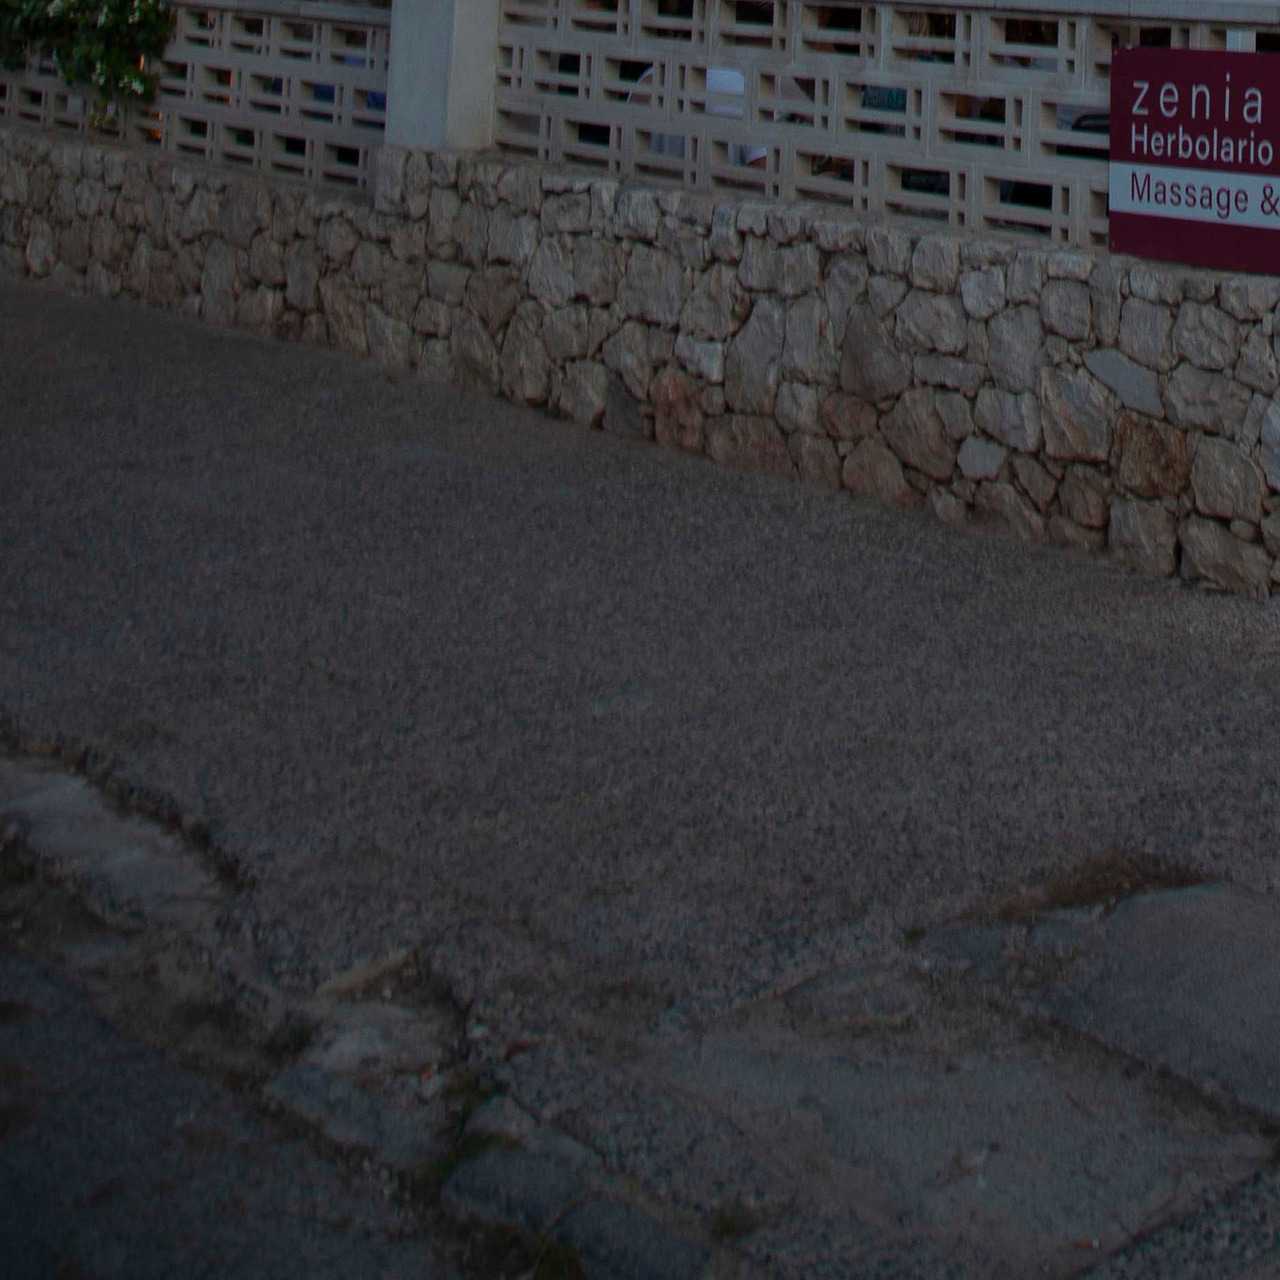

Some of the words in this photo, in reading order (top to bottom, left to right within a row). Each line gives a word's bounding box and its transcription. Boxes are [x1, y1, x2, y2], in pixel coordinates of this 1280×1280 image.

[1131, 72, 1263, 124] zenia
[1131, 122, 1274, 166] Herbolario
[1130, 171, 1249, 220] Massage
[1260, 184, 1280, 217] &
